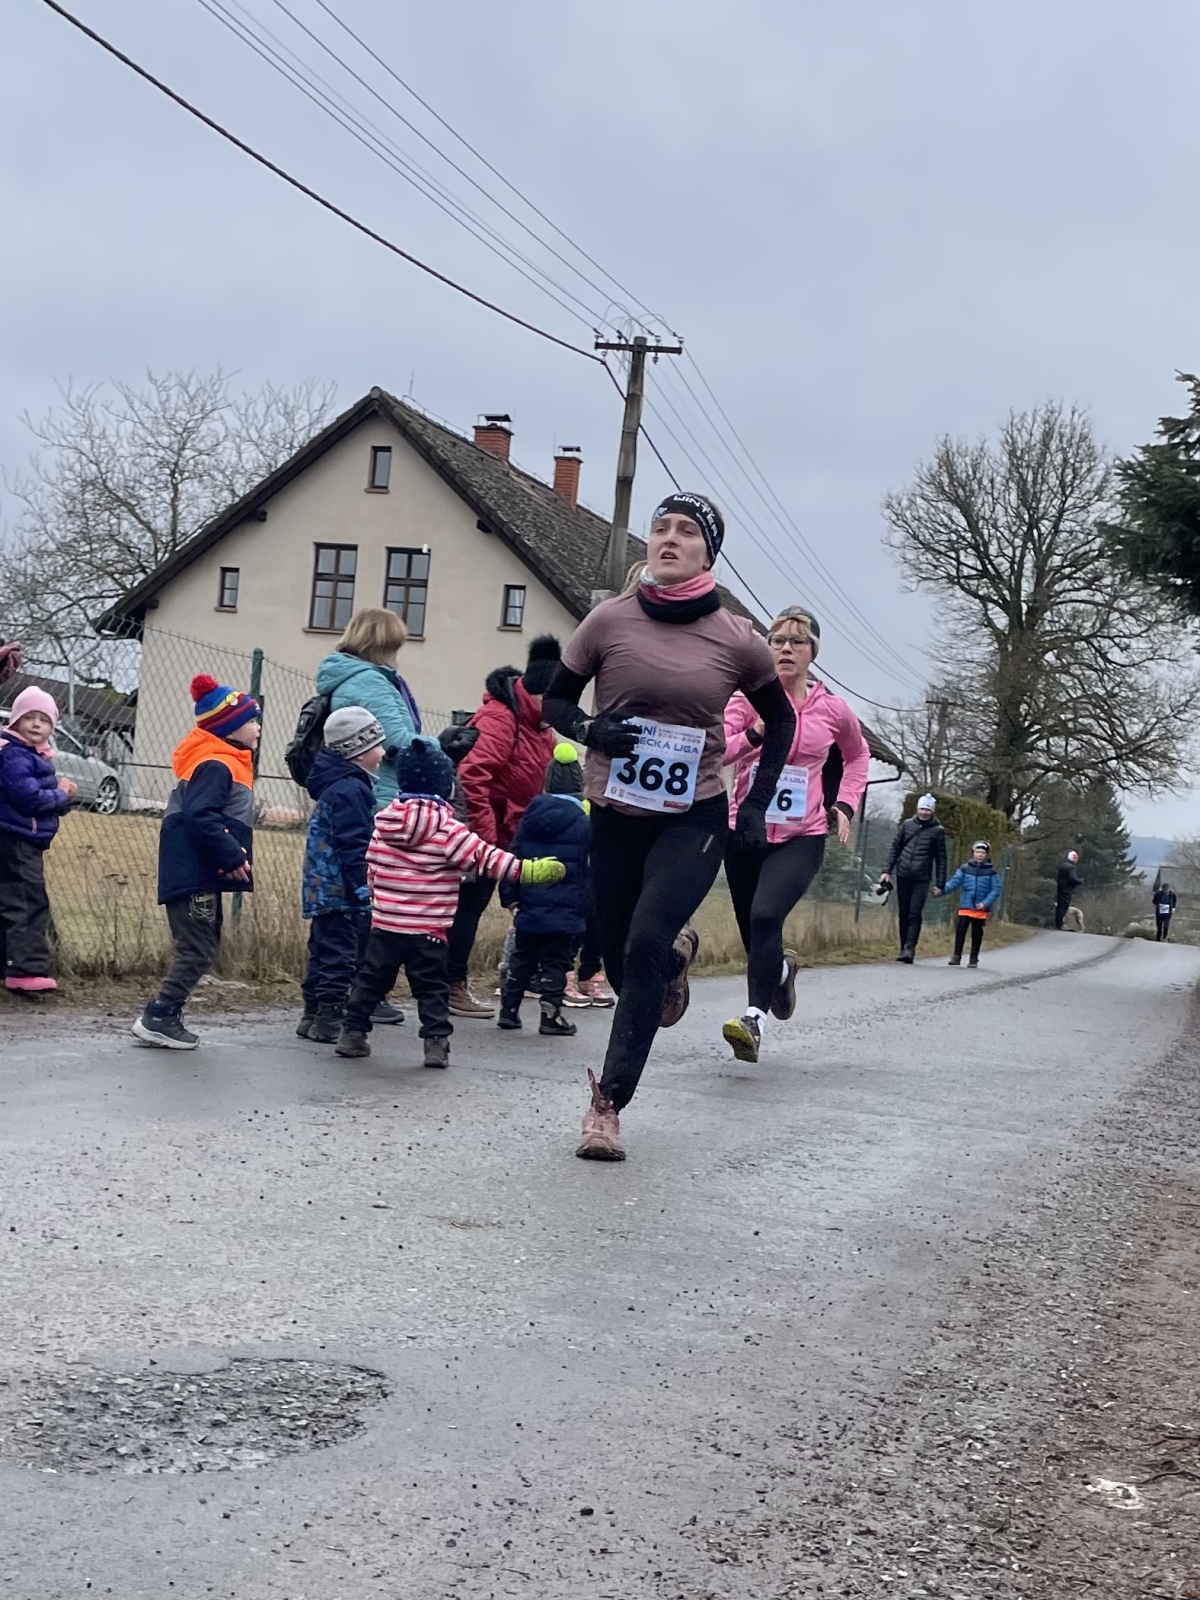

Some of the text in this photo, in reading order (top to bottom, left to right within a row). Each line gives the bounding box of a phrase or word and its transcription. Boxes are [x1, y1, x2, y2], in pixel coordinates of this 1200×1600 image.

[639, 738, 670, 749] ECKÁ
[674, 743, 699, 755] LIGA
[616, 754, 690, 795] 368
[777, 788, 793, 812] 6
